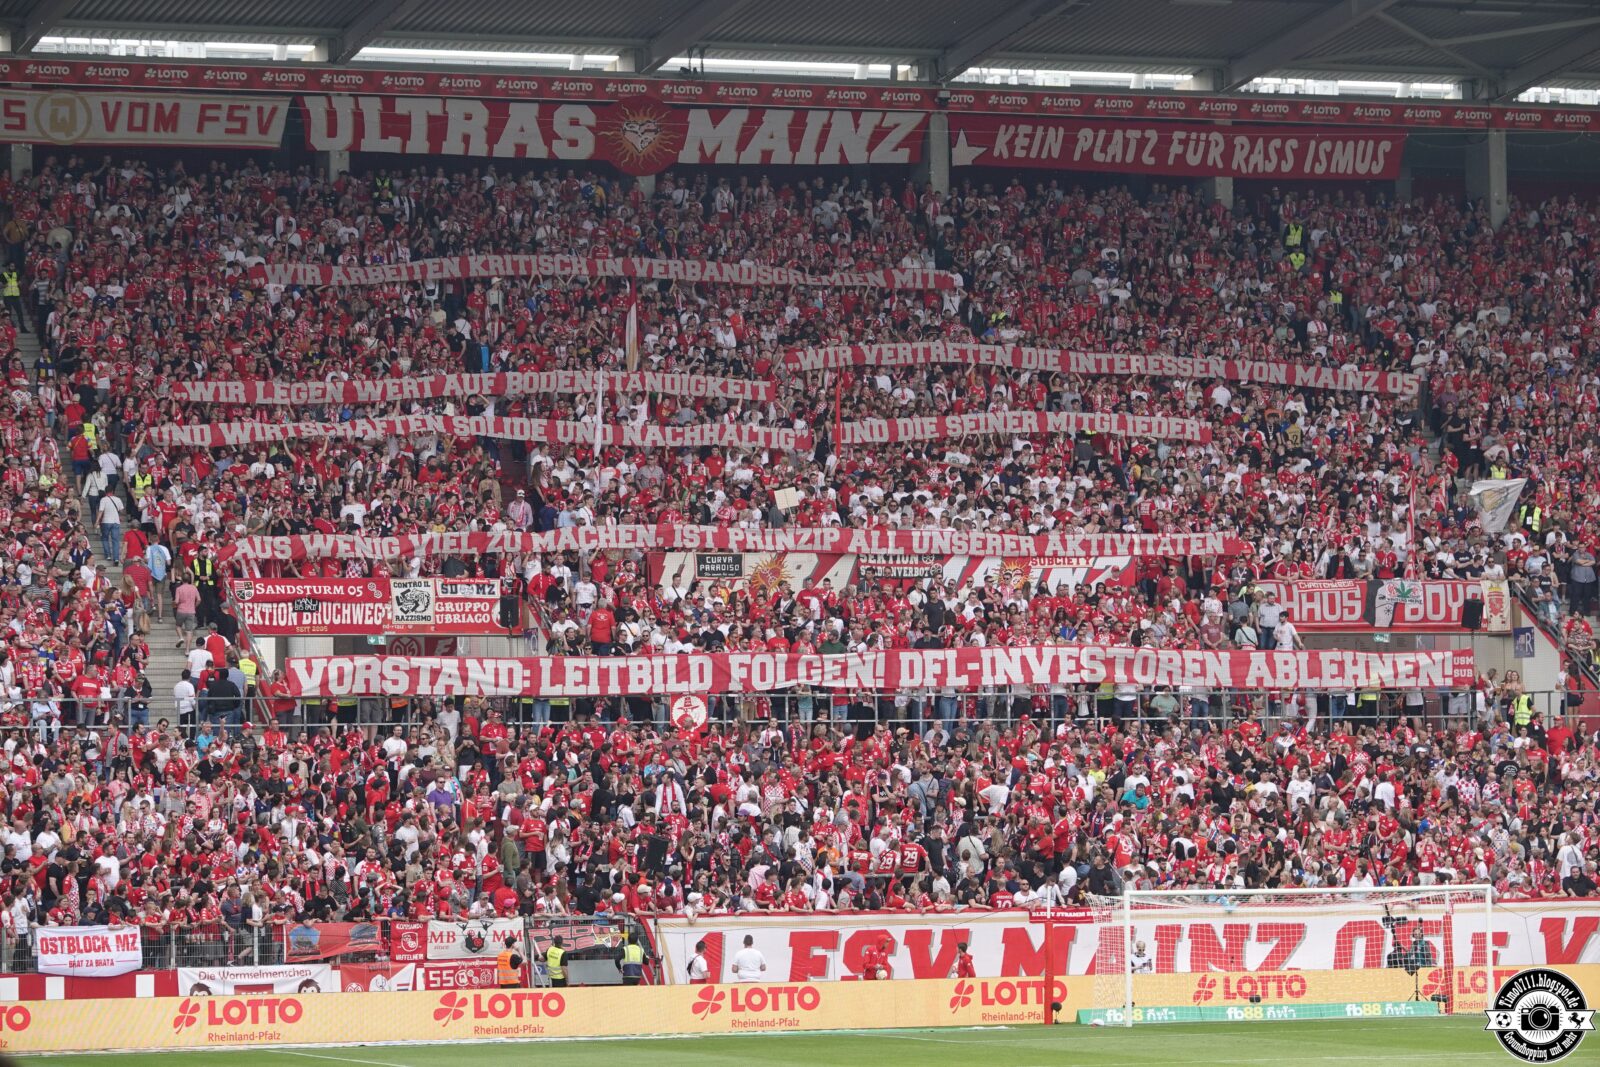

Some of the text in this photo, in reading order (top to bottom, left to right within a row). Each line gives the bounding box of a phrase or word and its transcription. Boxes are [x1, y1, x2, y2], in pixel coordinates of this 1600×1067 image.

[38, 65, 71, 75] LOTTO
[98, 67, 130, 77] LOTTO
[158, 69, 190, 79] LOTTO
[217, 71, 248, 81] LOTTO
[276, 73, 306, 83] LOTTO
[334, 74, 365, 84] LOTTO
[394, 76, 425, 86] LOTTO
[452, 78, 482, 88] LOTTO
[508, 80, 538, 90] LOTTO
[563, 82, 594, 92] LOTTO
[618, 83, 647, 93] LOTTO
[673, 85, 703, 95] LOTTO
[728, 87, 758, 97] LOTTO
[784, 89, 813, 99] LOTTO
[838, 90, 868, 100] LOTTO
[893, 92, 921, 102] LOTTO
[1000, 96, 1028, 106] LOTTO
[1053, 97, 1082, 107] LOTTO
[1105, 99, 1134, 109] LOTTO
[1158, 101, 1186, 111] LOTTO
[1211, 102, 1238, 112] LOTTO
[1262, 104, 1290, 114] LOTTO
[1314, 106, 1341, 116] LOTTO
[1365, 107, 1392, 117] LOTTO
[1415, 109, 1442, 119] LOTTO
[1465, 111, 1492, 121] LOTTO
[101, 101, 181, 133] VOM
[196, 103, 279, 135] FSV
[1515, 112, 1542, 122] LOTTO
[1565, 114, 1592, 124] LOTTO
[303, 96, 928, 165] ULTRAS MAINZ
[993, 124, 1064, 160] KEIN
[1073, 126, 1158, 165] PLATZ
[1167, 131, 1225, 169] FÜR
[330, 257, 464, 286] ARBEITEN
[469, 254, 591, 277] KRITISCH
[597, 256, 625, 277] IN
[631, 257, 889, 288] VERBANDSGREMIEN
[864, 341, 1014, 367] VERTRETEN
[1021, 346, 1061, 372] DIE
[1067, 351, 1227, 379] INTERESSEN
[1235, 359, 1288, 385] VON
[1294, 364, 1380, 393] MAINZ
[1386, 372, 1420, 394] 05
[255, 381, 345, 404] LEGEN
[353, 376, 436, 403] WERT
[443, 372, 498, 398] AUF
[150, 425, 212, 447] UND
[219, 414, 448, 445] WIRTSCHAFTEN
[451, 414, 548, 442] SOLIDE
[556, 419, 614, 445] UND
[841, 420, 887, 444] UND
[896, 416, 939, 441] DIE
[946, 410, 1041, 437] SEINER
[236, 535, 293, 560] AUS
[300, 533, 400, 560] WENIG
[407, 531, 478, 555] VIEL
[487, 530, 522, 553] ZU
[530, 524, 664, 551] MACHEN,
[672, 524, 722, 548] IST
[728, 526, 841, 550] PRINZIP
[848, 528, 904, 554] ALL
[910, 530, 1038, 556] UNSERER
[860, 553, 918, 565] SEKTION
[1031, 556, 1092, 567] SUBCIETY
[699, 564, 740, 572] PARADISO
[255, 582, 345, 595] SANDSTURM
[393, 580, 431, 589] CONTRO IL
[441, 583, 496, 595] SD MZ
[435, 601, 490, 612] GRUPPO
[435, 613, 491, 624] UBRIAGO
[1453, 656, 1474, 666] USM
[290, 647, 1453, 697] VORSTAND: LEITBILD FOLGEN! DFL-INVESTOREN ABLEHNEN!
[1453, 668, 1473, 678] SUB
[904, 851, 918, 865] 29
[429, 930, 457, 944] MB
[40, 933, 139, 955] OSTBLOCK MZ
[788, 928, 971, 982] FSV
[1001, 922, 1306, 977] MAINZ
[68, 959, 114, 968] BRAT ZA BRATA
[199, 967, 312, 980] Die Wormselmenschen
[1223, 974, 1307, 1000] LOTTO
[1457, 970, 1520, 994] LOT
[981, 980, 1067, 1006] LOTTO
[731, 985, 820, 1012] LOTTO
[473, 991, 566, 1019] LOTTO
[1345, 1003, 1382, 1017] fb88
[207, 998, 303, 1025] LOTTO
[981, 1010, 1046, 1021] Rheinland-Pfal
[1226, 1005, 1264, 1019] fb88
[731, 1017, 800, 1028] Rheinland-Pfalz
[473, 1024, 545, 1035] Rheinland-Pfalz
[208, 1030, 281, 1042] Rheinland-Pfalz
